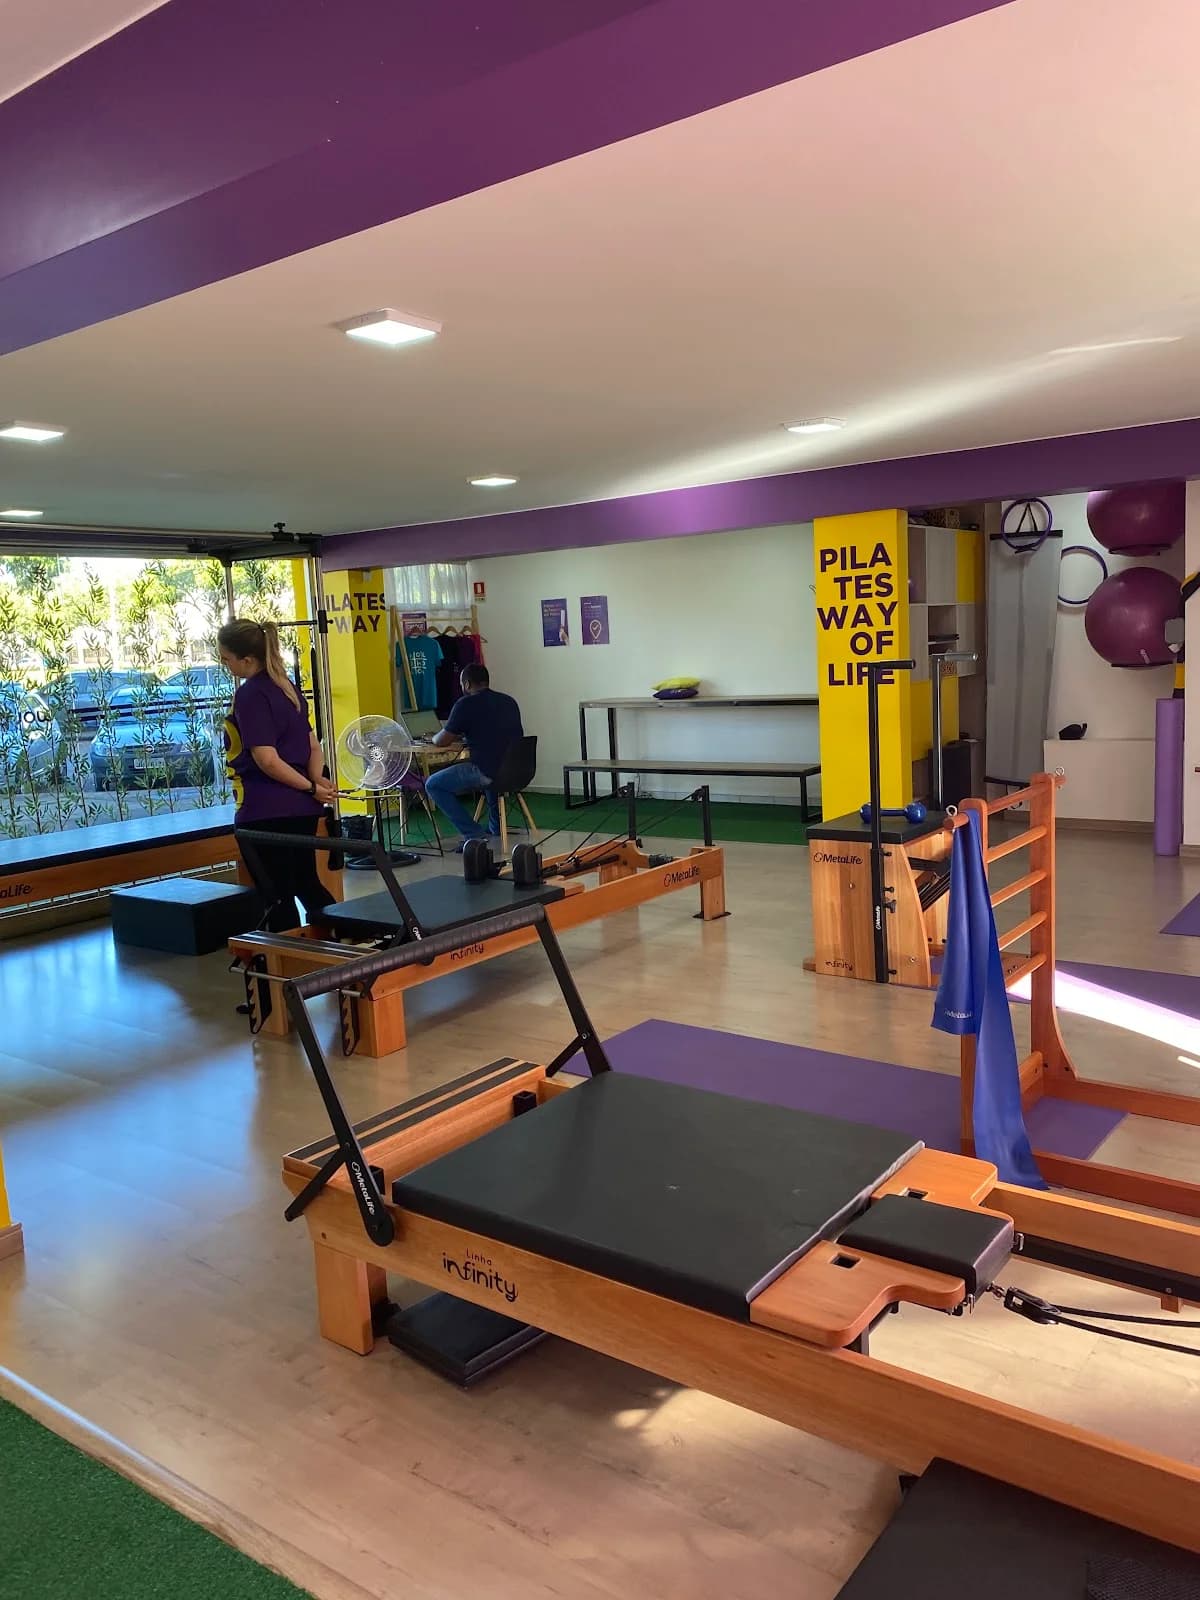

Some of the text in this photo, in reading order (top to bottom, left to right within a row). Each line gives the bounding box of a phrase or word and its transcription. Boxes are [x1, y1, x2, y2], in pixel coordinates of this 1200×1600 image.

[820, 542, 892, 572] PILA
[833, 572, 894, 600] TES
[315, 592, 386, 612] ILATES
[334, 614, 381, 634] WAY
[817, 601, 898, 630] WAY
[850, 630, 894, 656] OF
[823, 853, 863, 865] MetaLife
[450, 943, 484, 961] infinity
[355, 1172, 375, 1215] MetaLife
[466, 1248, 492, 1266] Linha
[442, 1252, 519, 1302] infinity
